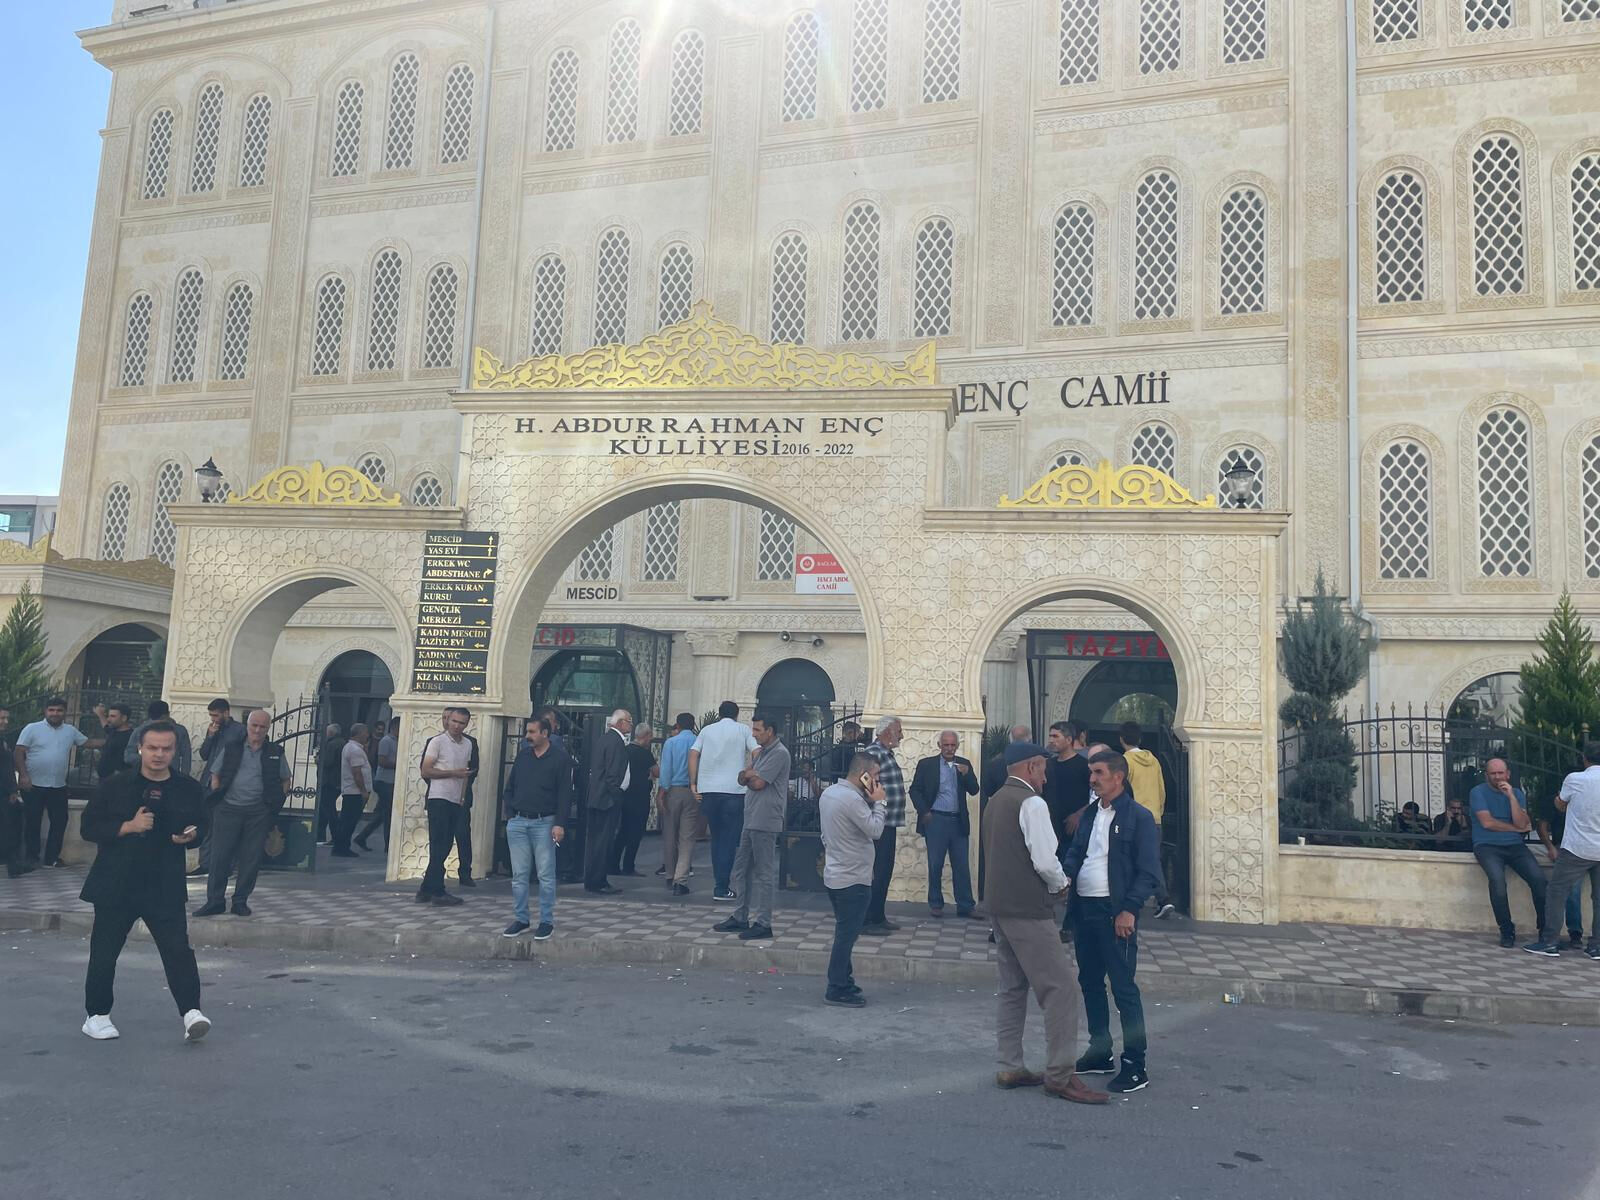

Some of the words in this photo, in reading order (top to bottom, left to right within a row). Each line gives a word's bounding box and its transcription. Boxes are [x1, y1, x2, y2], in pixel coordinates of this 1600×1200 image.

[958, 380, 1029, 416] ENÇ
[515, 417, 543, 434] H.
[820, 416, 884, 437] ENÇ
[609, 434, 781, 456] KÜLLİYESİ
[782, 443, 810, 455] 2016
[824, 443, 854, 455] 2022
[430, 534, 462, 544] MESCİD
[428, 547, 443, 555] YAS
[445, 546, 459, 555] EVİ
[427, 559, 455, 567] ERKEK
[426, 569, 481, 578] ABDESTHANE
[425, 582, 453, 591] ERKEK
[455, 583, 484, 592] KURAN
[424, 592, 452, 601] KURSU
[566, 585, 618, 600] MESCİD
[422, 605, 461, 615] GENÇLİK
[421, 616, 461, 625] MERKEZİ
[420, 628, 449, 637] KADIN
[420, 637, 449, 646] TAZİYE
[450, 638, 464, 647] EVİ
[535, 627, 576, 648] CİD
[419, 651, 446, 659] KADIN
[447, 652, 461, 660] WC
[418, 660, 473, 669] ABDESTHANE
[416, 673, 431, 681] KIZ
[433, 674, 462, 682] KURAN
[416, 682, 444, 690] KURSU
